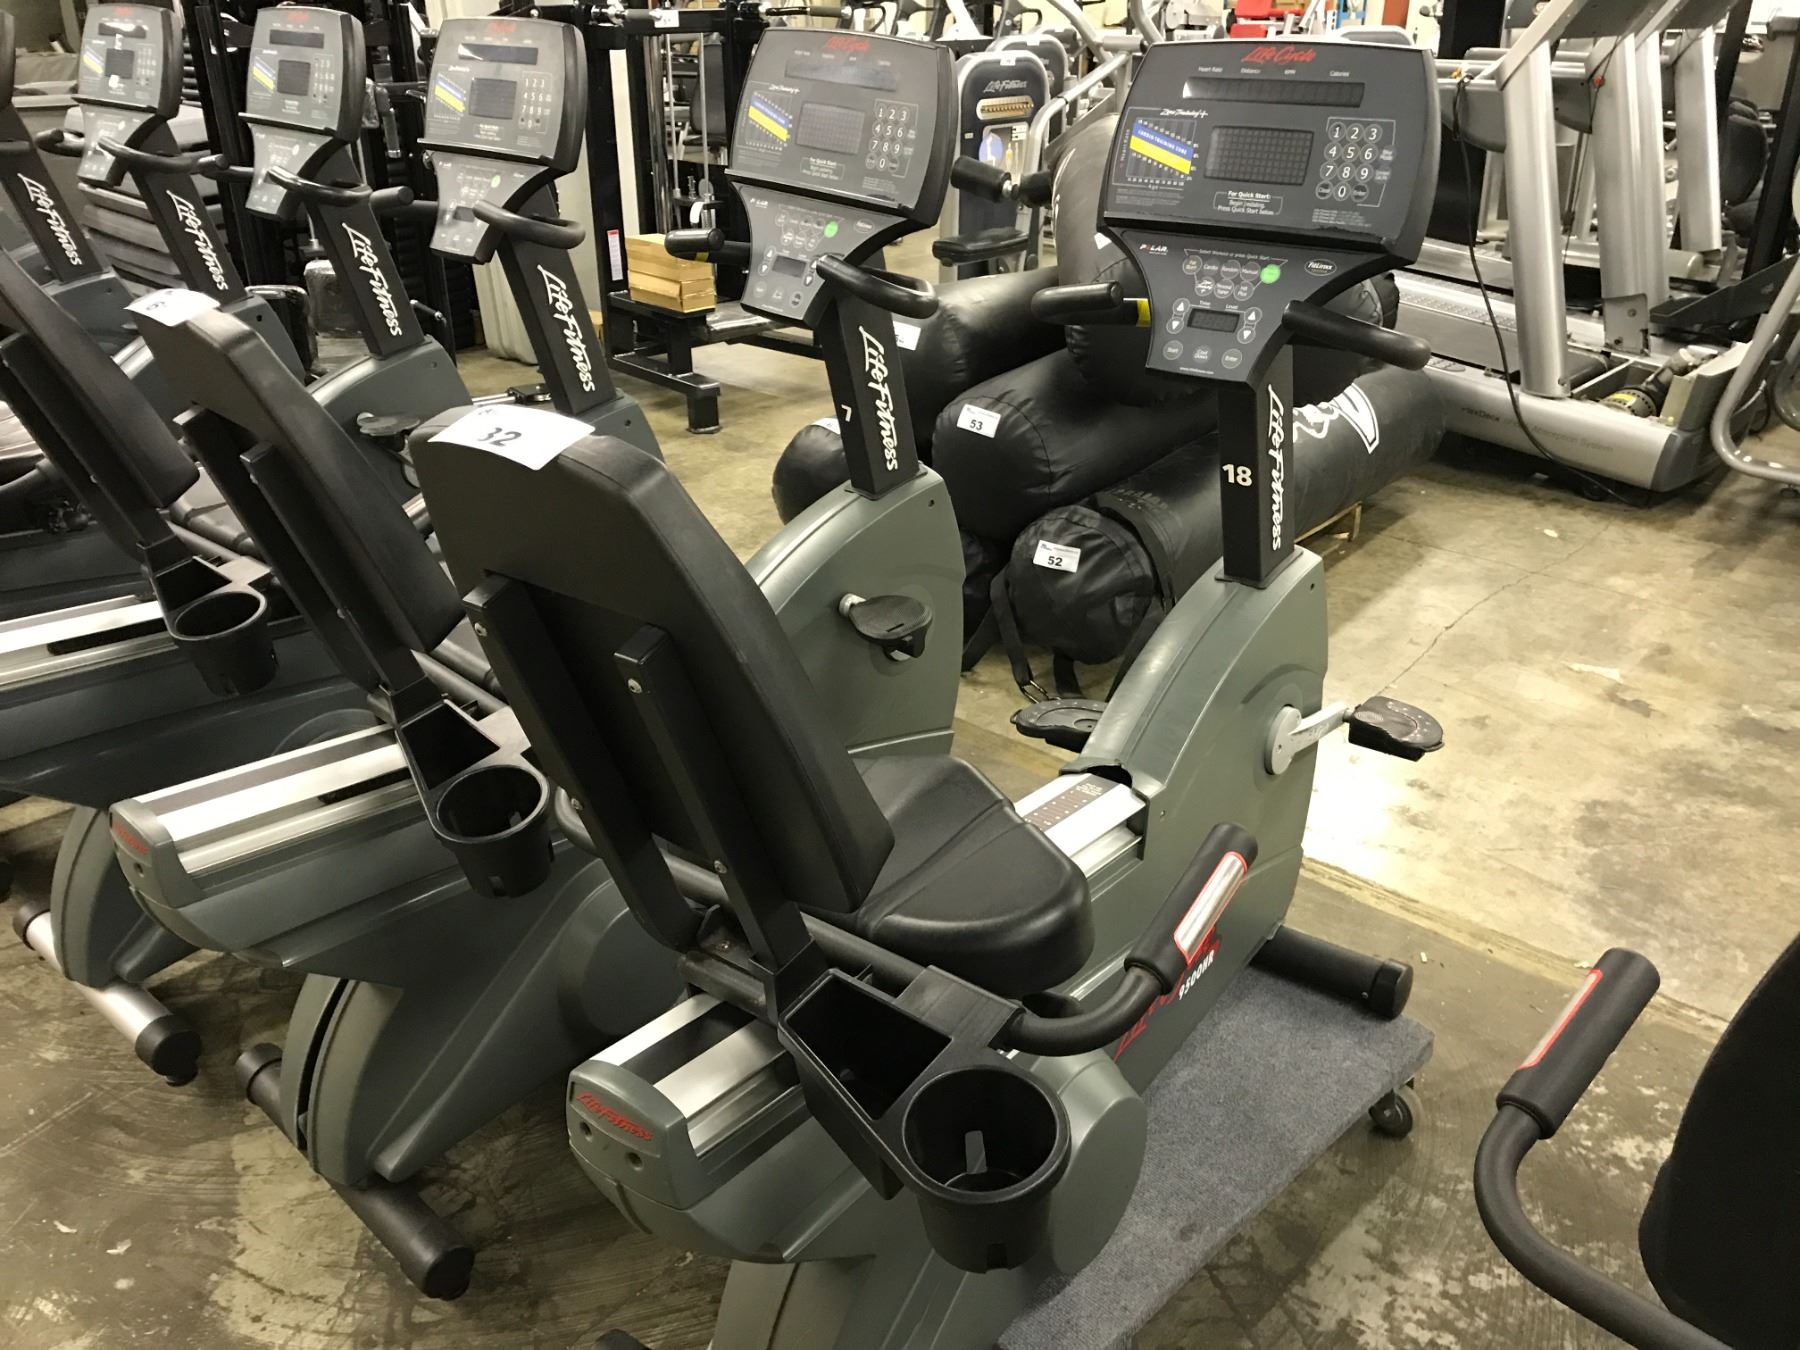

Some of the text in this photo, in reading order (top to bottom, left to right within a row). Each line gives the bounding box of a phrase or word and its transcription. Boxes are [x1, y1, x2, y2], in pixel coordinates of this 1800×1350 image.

[1333, 126, 1378, 140] 1 2 3
[1328, 146, 1337, 157] 4
[1346, 146, 1356, 158] 5
[1364, 148, 1373, 160] 6
[1325, 165, 1334, 177] 7
[1342, 166, 1351, 178] 8
[1360, 167, 1369, 180] 9
[1338, 185, 1346, 198] 0
[970, 419, 983, 431] 53
[1222, 464, 1252, 487] 18
[1047, 556, 1063, 567] 52
